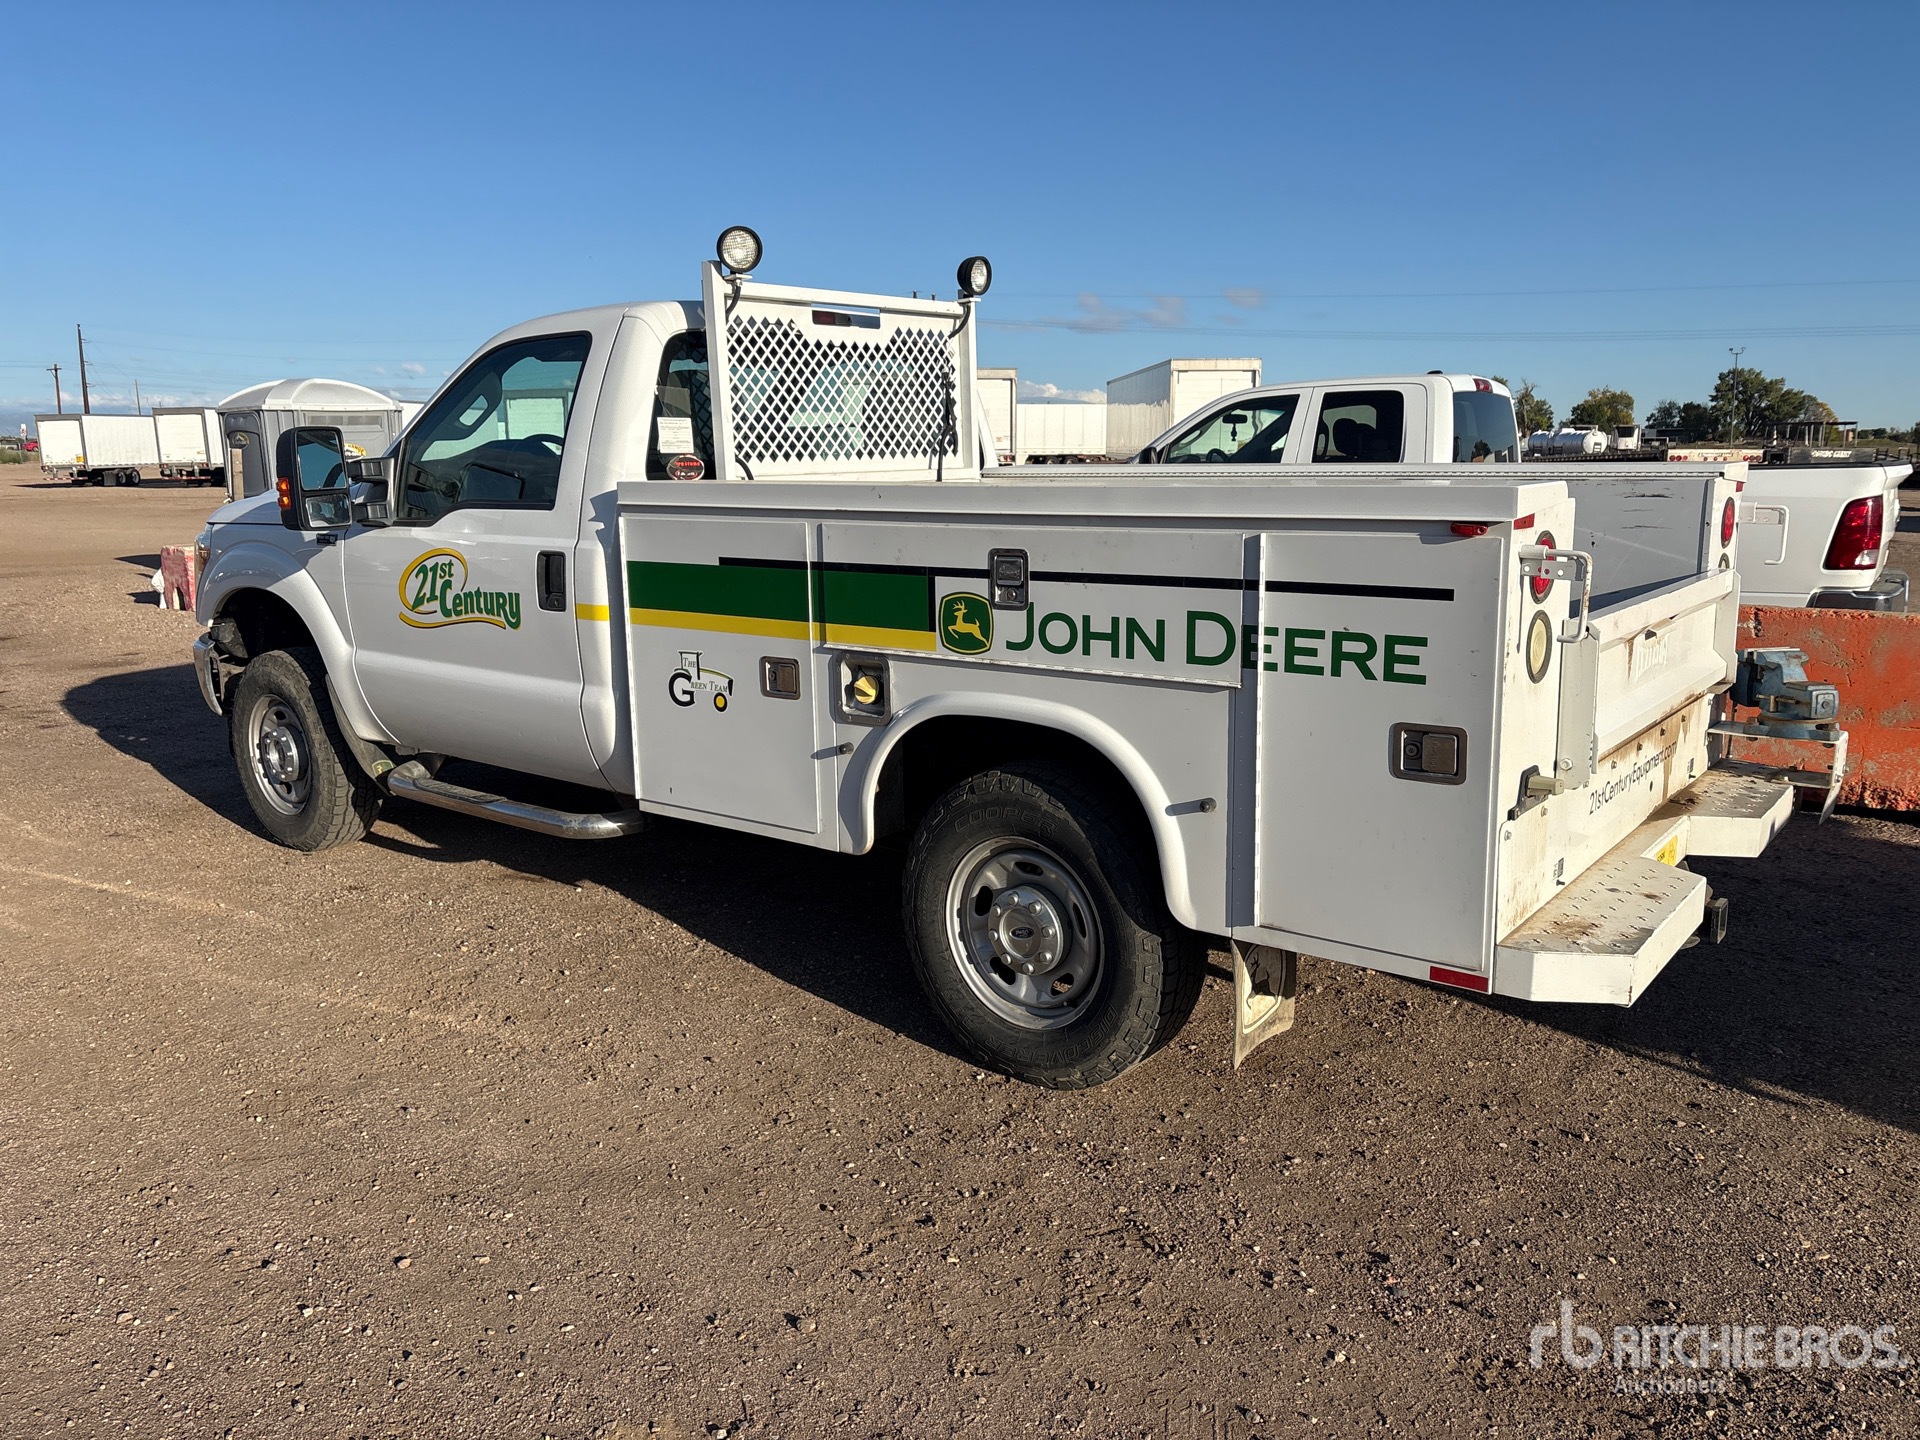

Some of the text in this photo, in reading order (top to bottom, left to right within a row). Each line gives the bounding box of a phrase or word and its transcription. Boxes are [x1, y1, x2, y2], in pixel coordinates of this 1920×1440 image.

[412, 559, 454, 611] 21st
[682, 657, 697, 669] THE
[1005, 602, 1428, 685] JOHN DEERE
[1589, 741, 1678, 815] 21stCenturyEquipment.com
